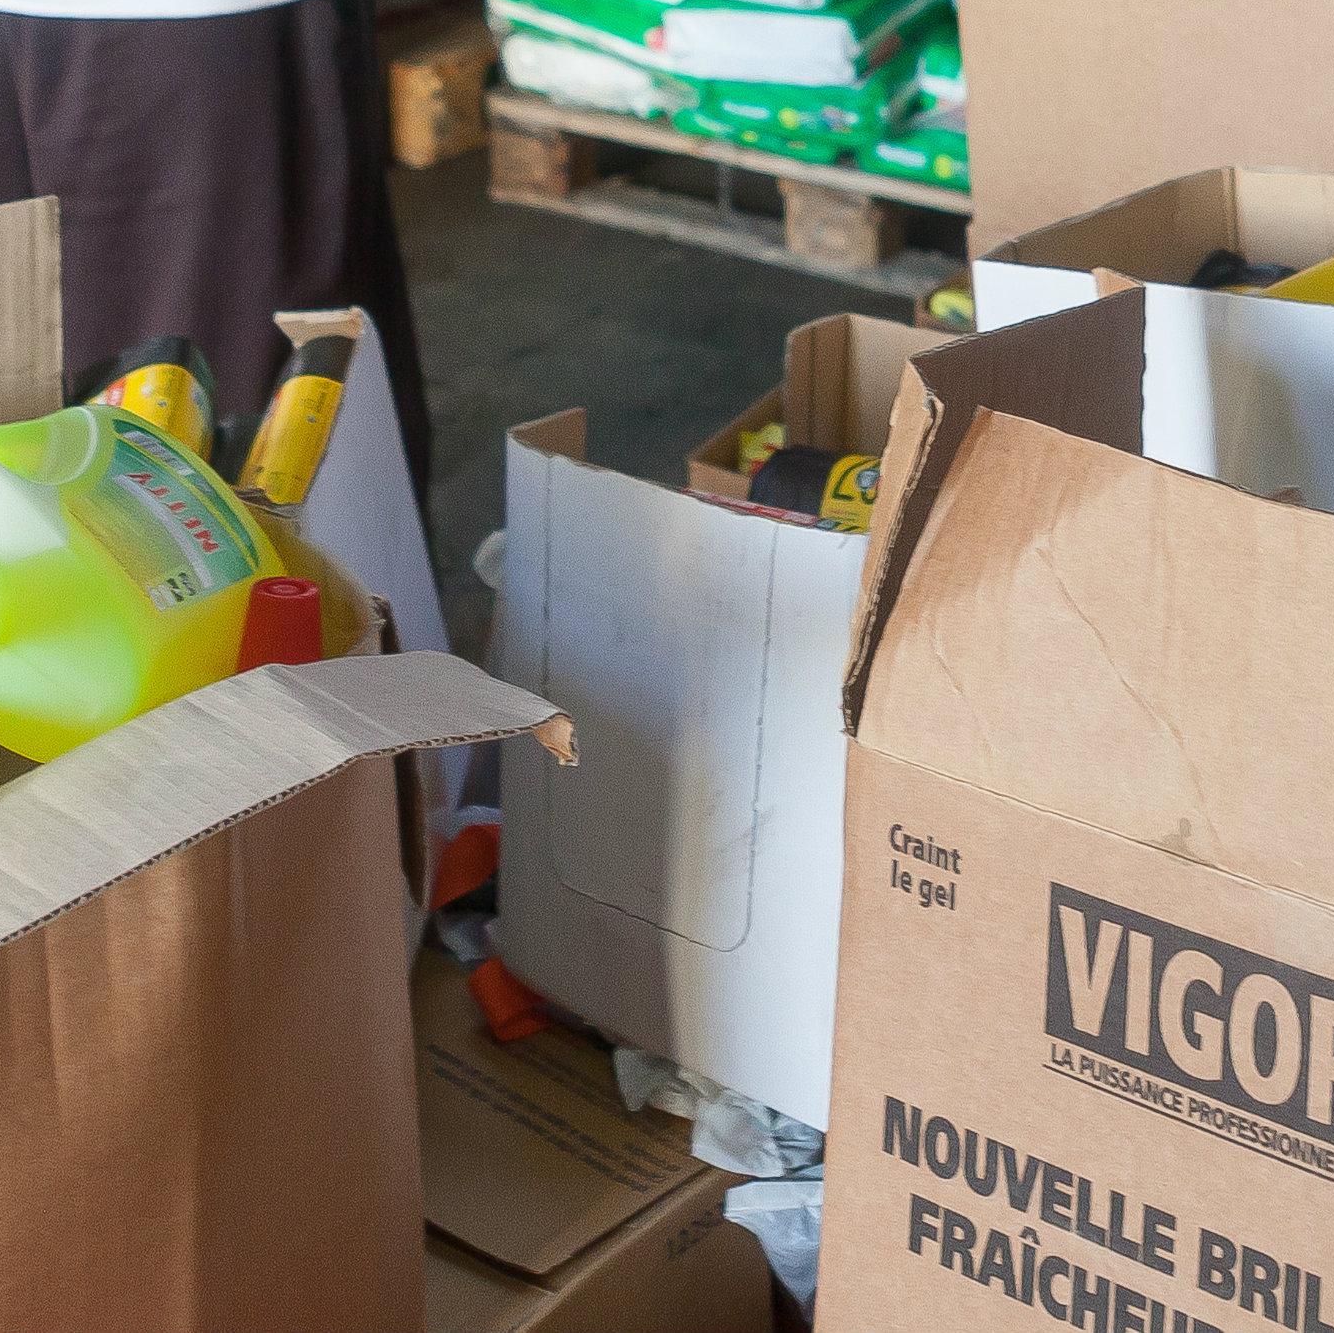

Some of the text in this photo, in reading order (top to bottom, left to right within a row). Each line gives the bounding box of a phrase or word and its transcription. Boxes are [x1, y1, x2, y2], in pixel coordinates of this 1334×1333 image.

[888, 822, 963, 875] Craint
[890, 859, 958, 911] le gel
[1050, 1042, 1076, 1072] LA
[1077, 1053, 1183, 1114] PUISSANCE
[881, 1095, 1178, 1278] NOUVELLE
[907, 1192, 1227, 1333] FRAÎCHE
